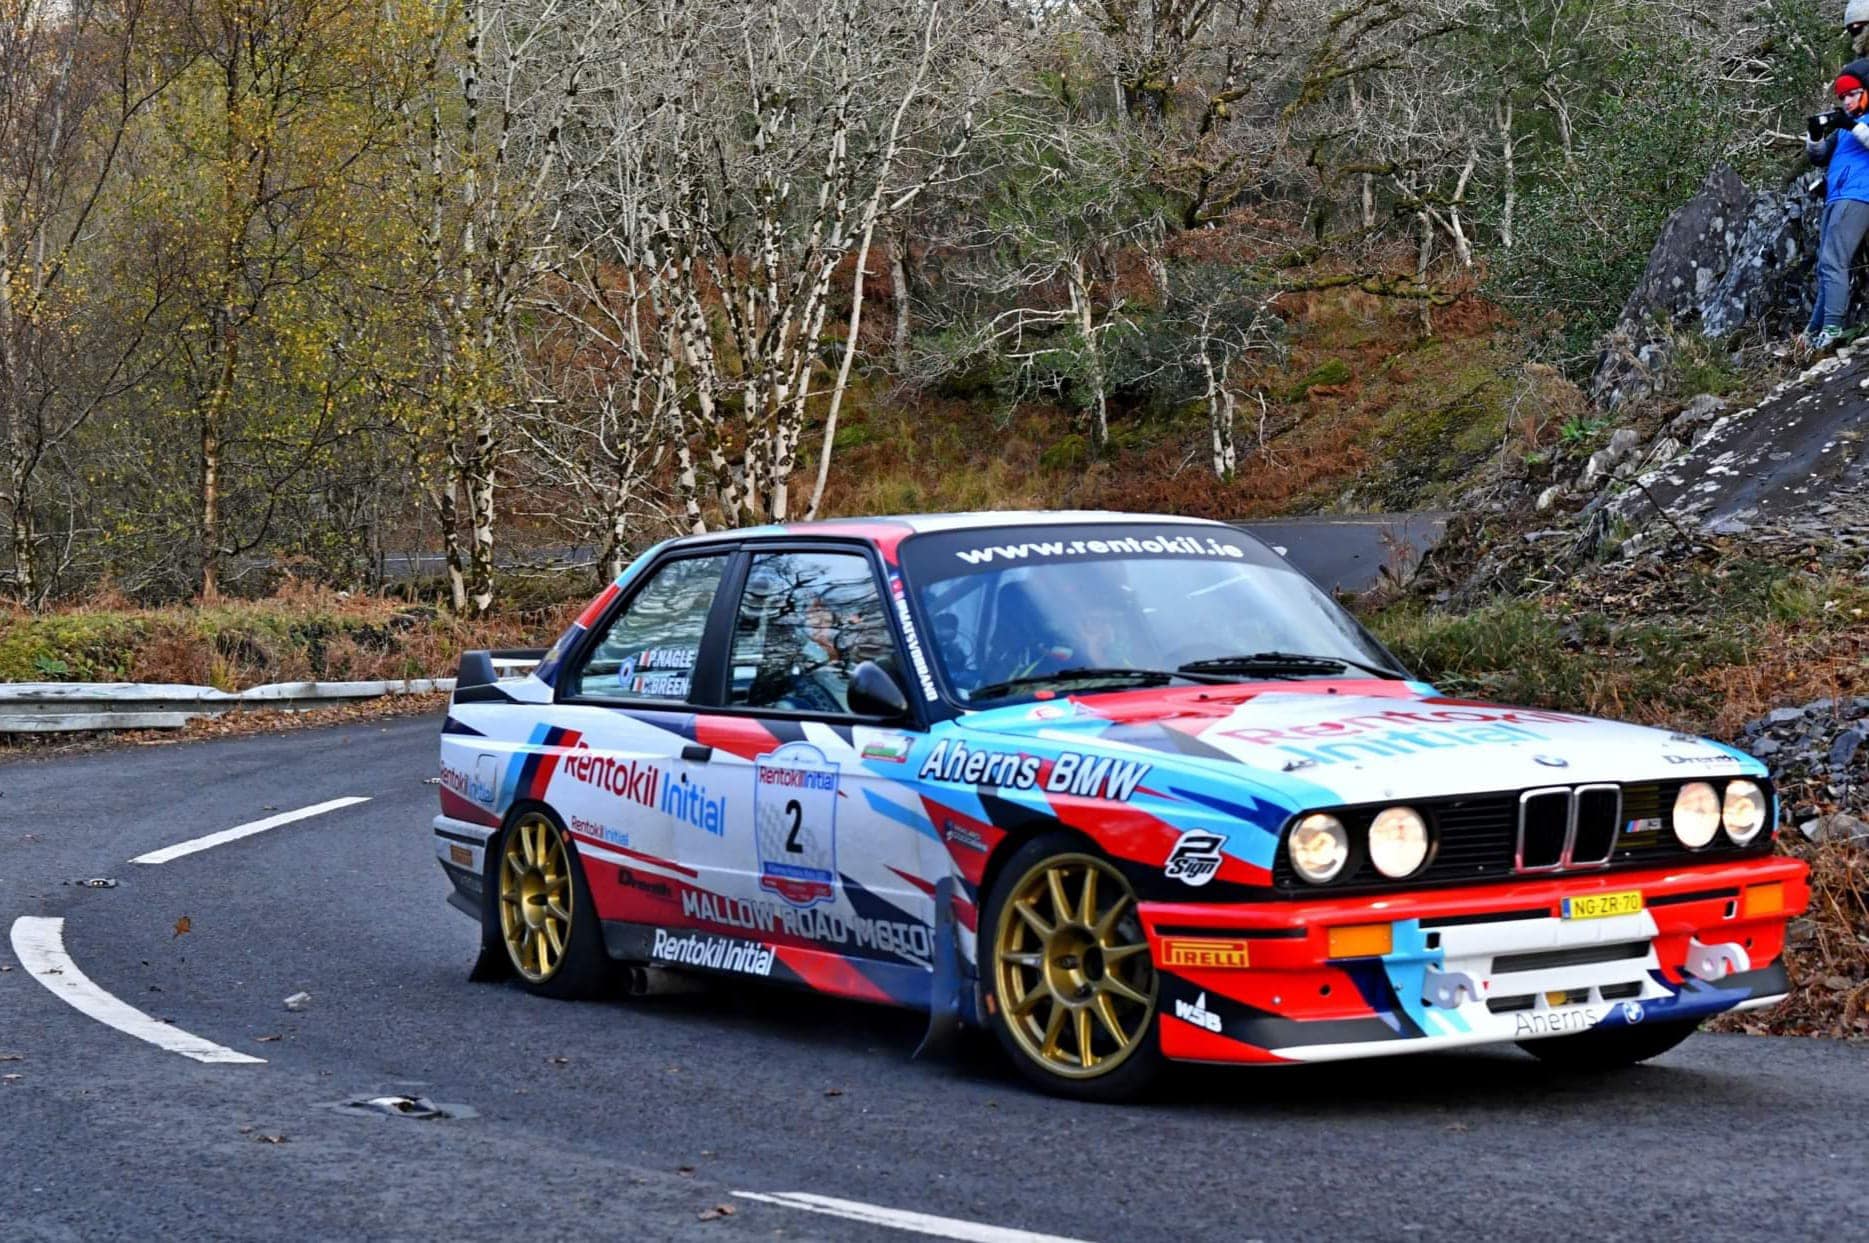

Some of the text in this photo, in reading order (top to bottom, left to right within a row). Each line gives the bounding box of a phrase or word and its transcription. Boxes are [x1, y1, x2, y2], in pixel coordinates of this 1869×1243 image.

[956, 536, 1245, 565] www.rentokil.ie
[649, 648, 695, 668] P.NAGLE
[919, 738, 1153, 802] Aherns BMW
[564, 739, 726, 837] Rentokil Initial
[785, 799, 804, 854] 2
[1168, 857, 1217, 879] Sign
[681, 888, 775, 933] MALLOW
[780, 905, 848, 944] ROAD
[1573, 894, 1639, 916] NG-ZR-70
[1163, 938, 1247, 967] PIRELLI
